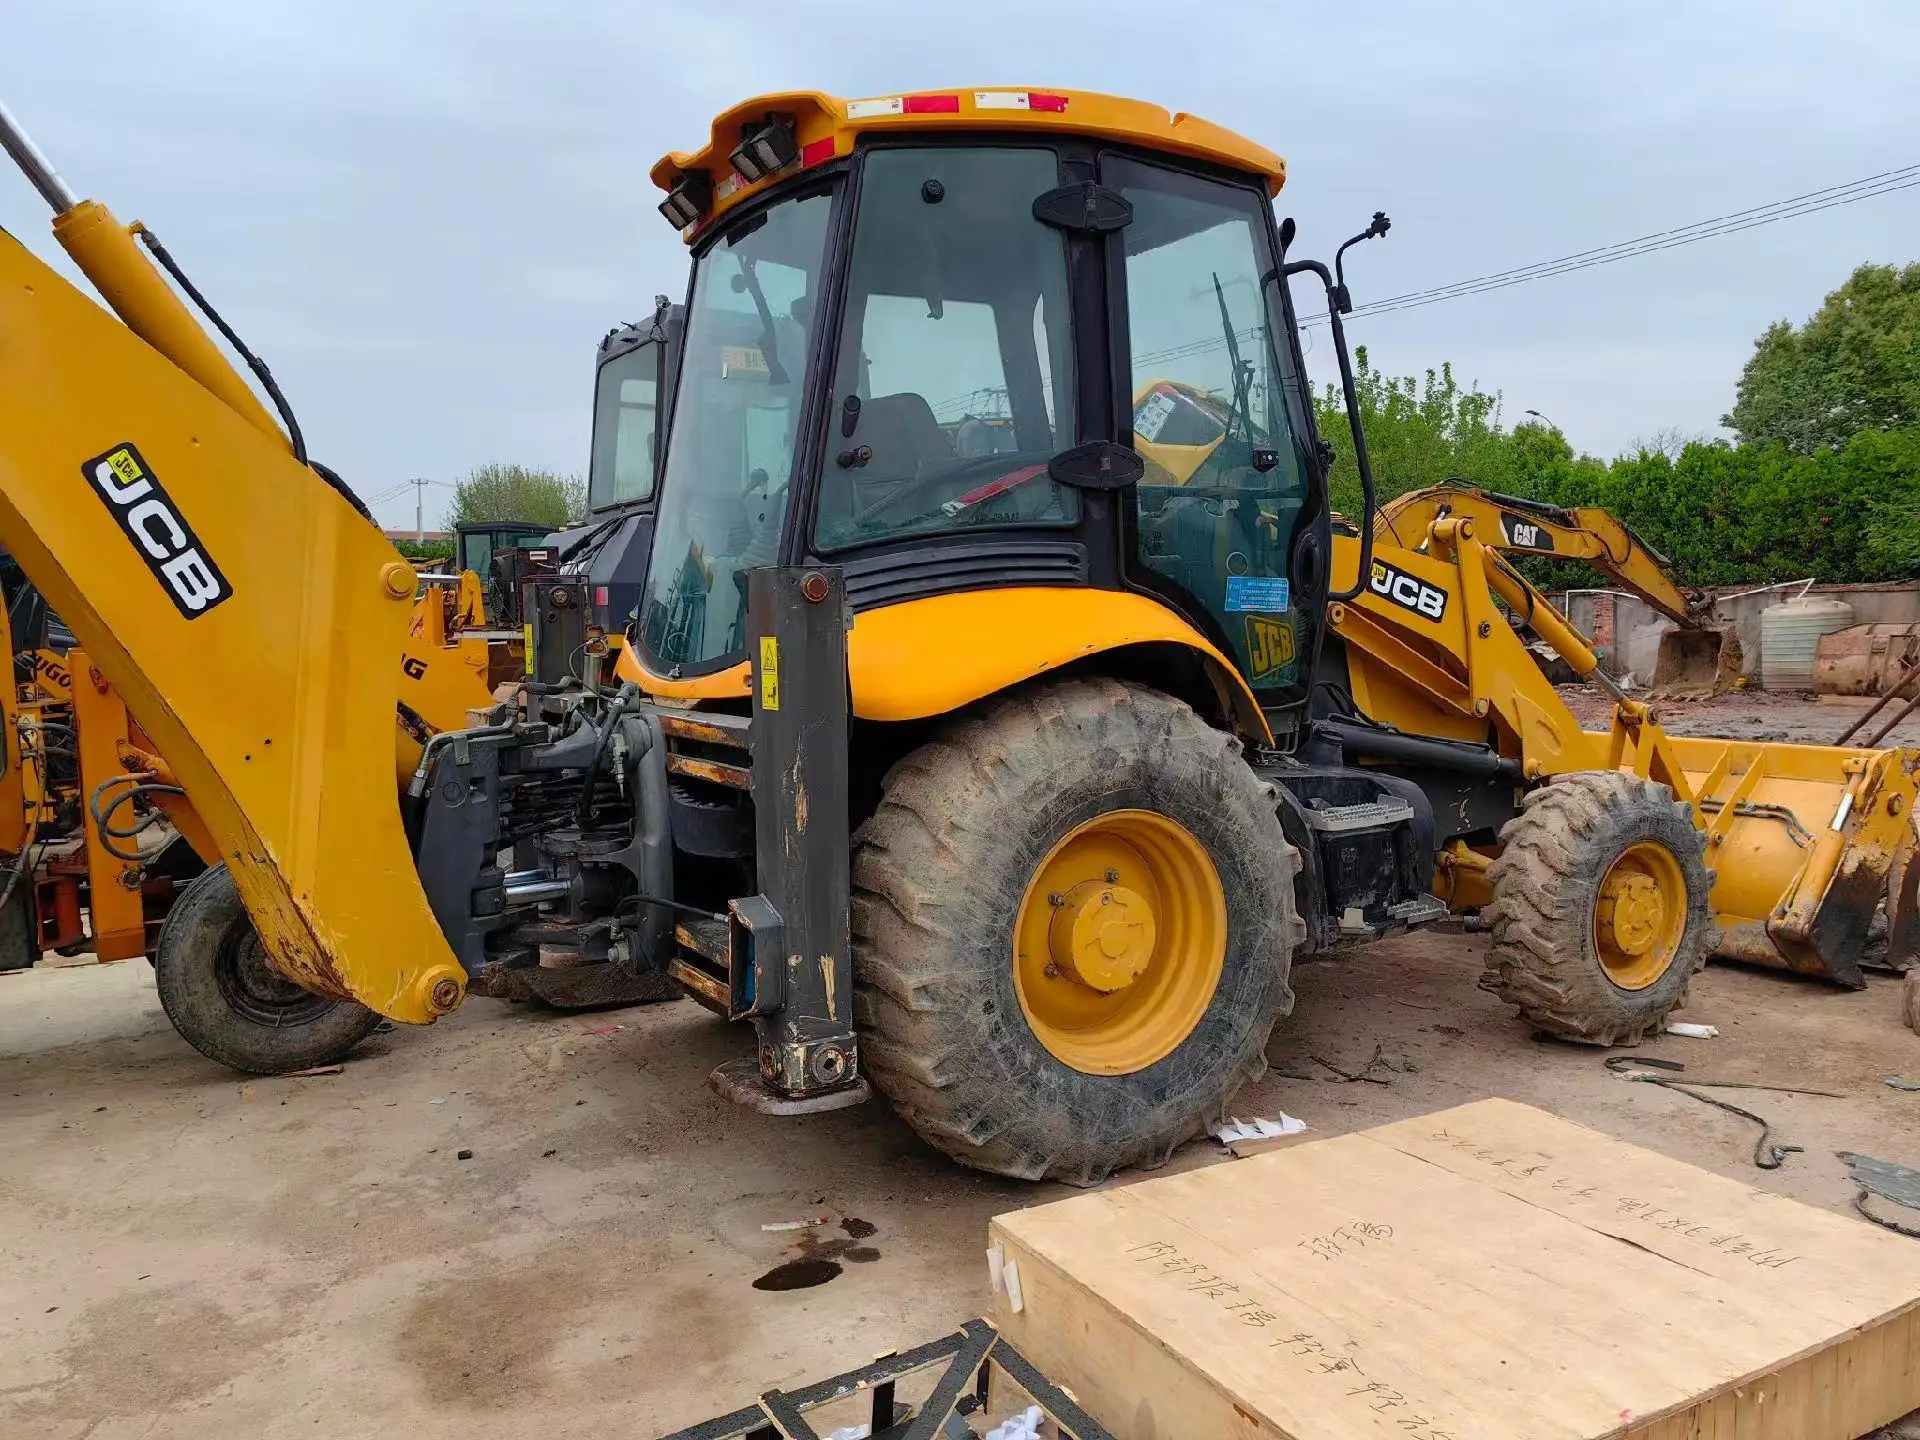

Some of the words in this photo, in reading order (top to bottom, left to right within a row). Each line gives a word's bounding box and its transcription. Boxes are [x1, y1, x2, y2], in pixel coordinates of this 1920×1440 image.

[115, 457, 136, 479] JCB
[95, 460, 221, 611] JCB
[1513, 523, 1539, 547] CAT
[1371, 569, 1444, 618] JCB
[401, 652, 428, 681] G
[1252, 622, 1293, 673] JCB
